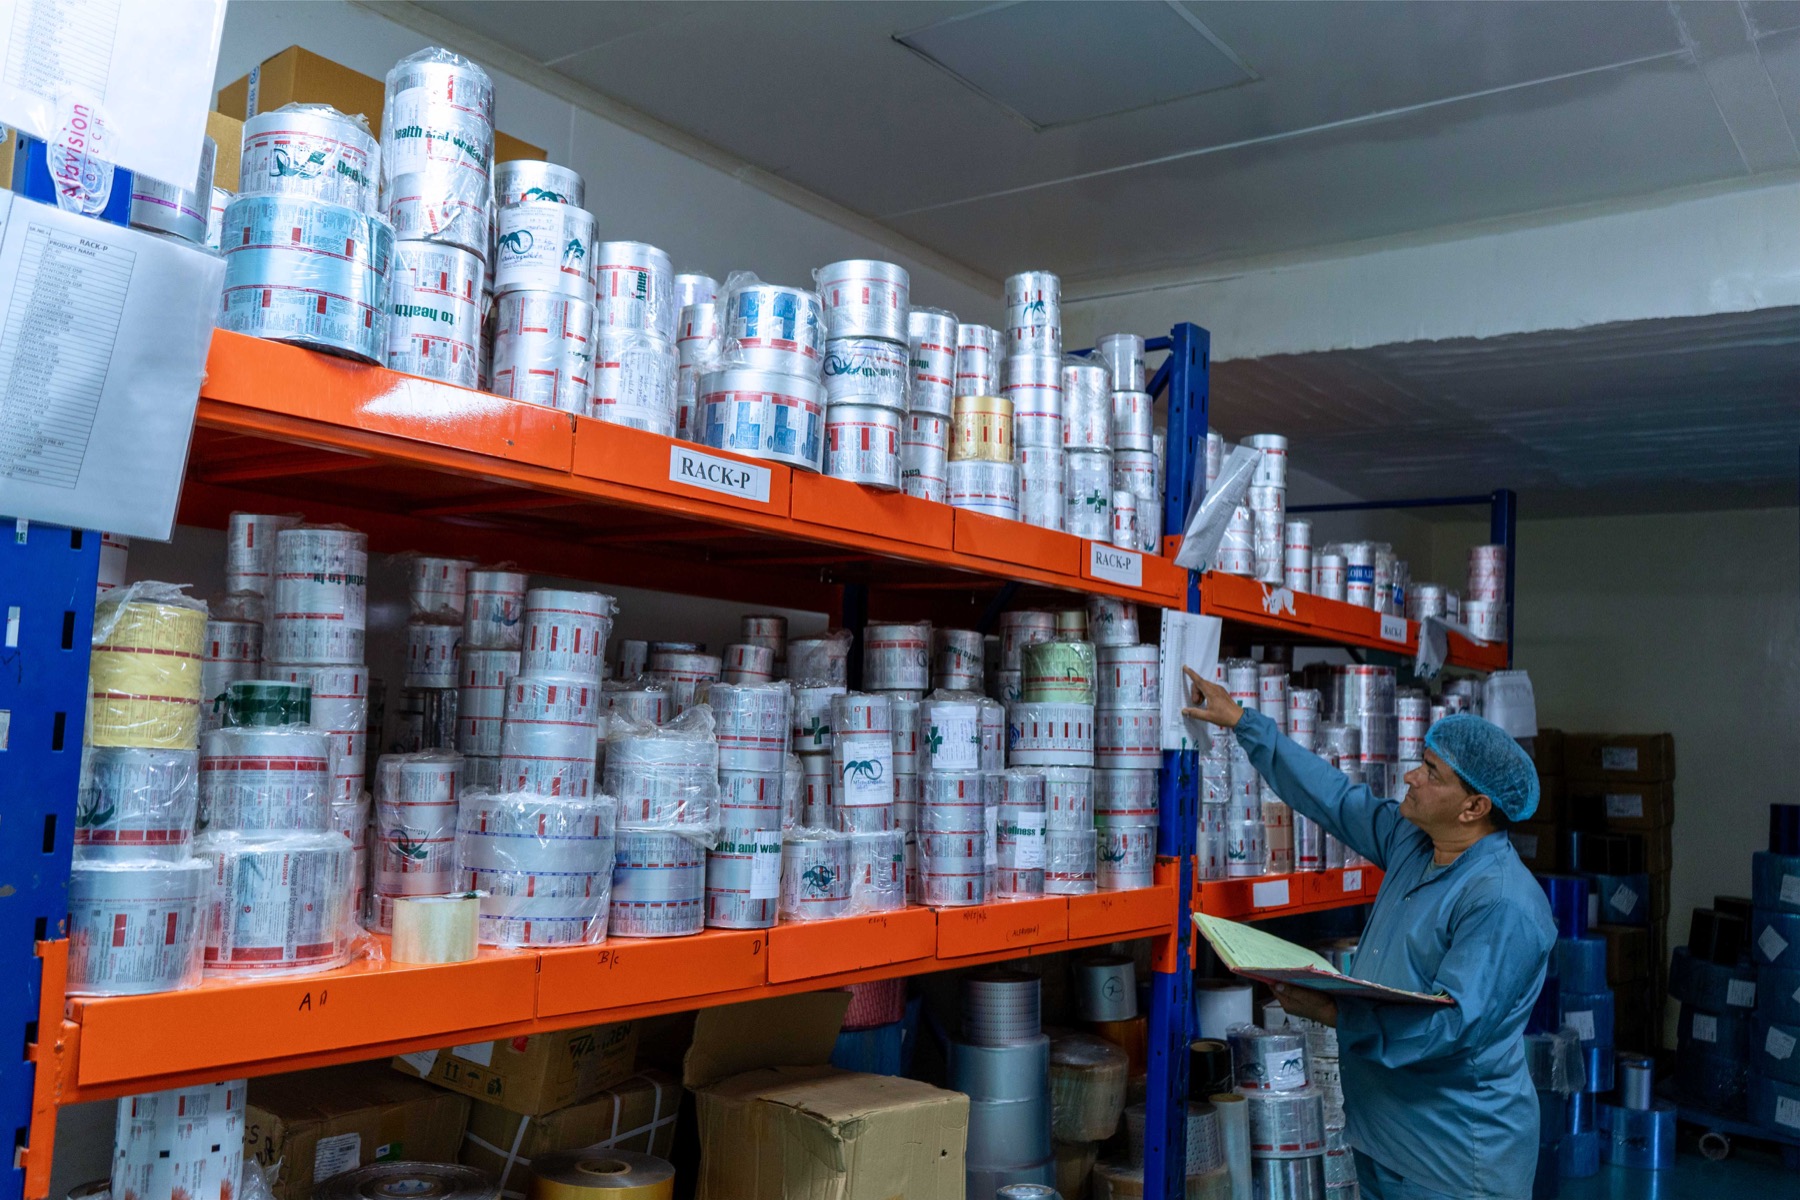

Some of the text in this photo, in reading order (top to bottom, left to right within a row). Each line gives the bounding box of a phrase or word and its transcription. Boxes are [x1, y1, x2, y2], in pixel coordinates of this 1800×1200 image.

[394, 125, 422, 140] health
[49, 240, 96, 256] PRODUCT NAME
[79, 239, 108, 251] RACK-P
[395, 304, 455, 326] to health
[681, 457, 752, 490] RACK-P
[1095, 552, 1132, 571] RACK-P
[1007, 826, 1036, 836] ellness
[737, 842, 758, 854] and
